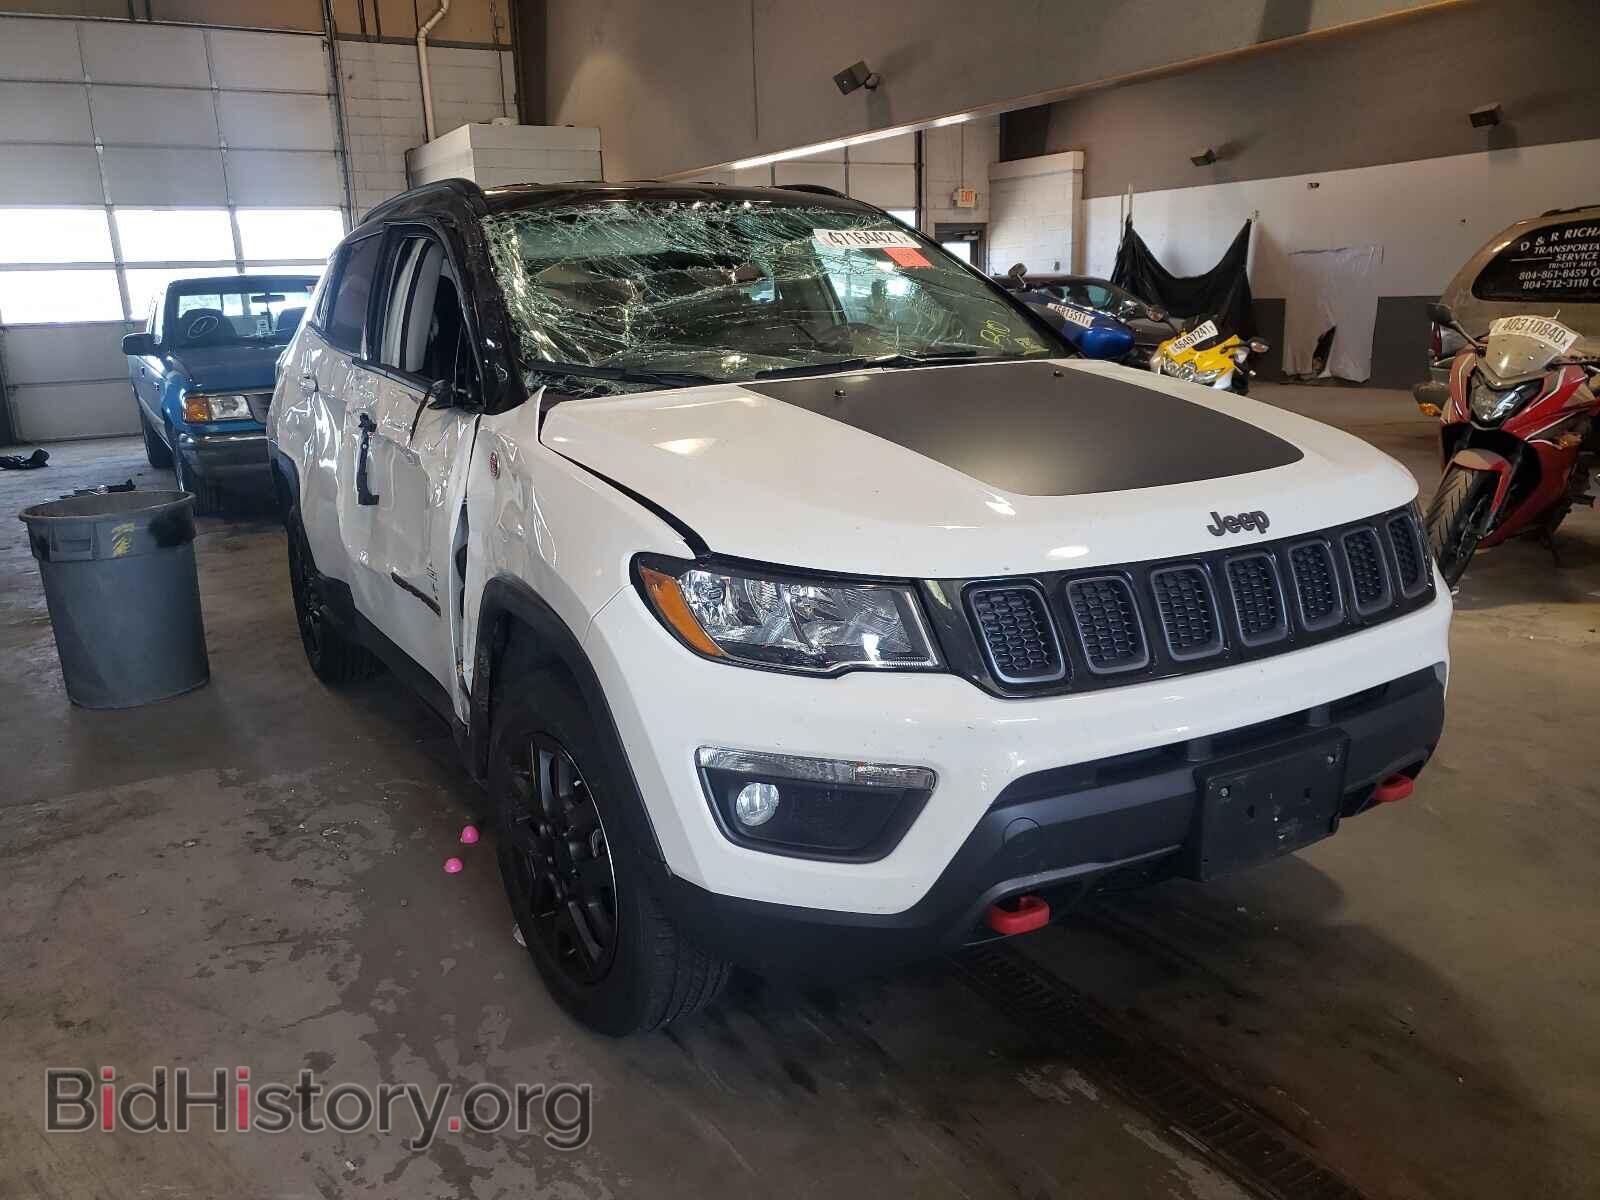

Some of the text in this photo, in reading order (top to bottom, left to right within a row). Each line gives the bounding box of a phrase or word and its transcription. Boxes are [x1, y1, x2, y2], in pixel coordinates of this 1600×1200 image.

[1520, 241, 1530, 251] D
[1536, 236, 1545, 246] &
[1551, 232, 1559, 242] R
[1556, 252, 1598, 261] SERVICE
[1503, 318, 1566, 343] 40310840
[1207, 511, 1270, 536] Jeep
